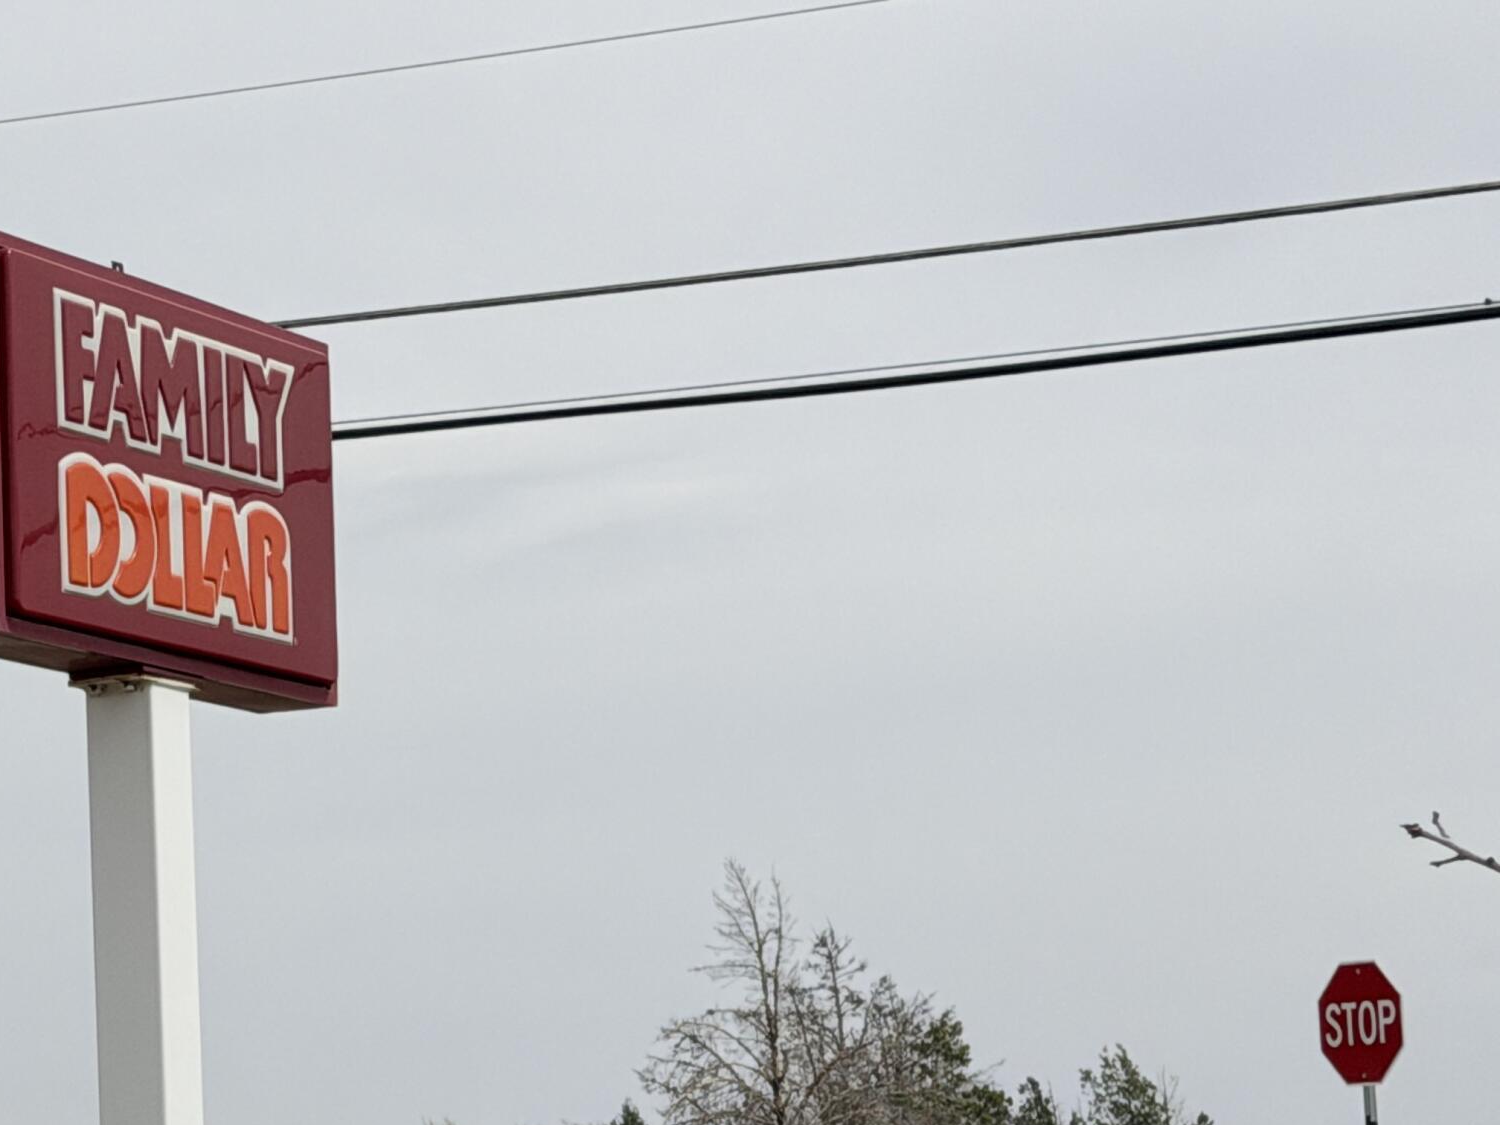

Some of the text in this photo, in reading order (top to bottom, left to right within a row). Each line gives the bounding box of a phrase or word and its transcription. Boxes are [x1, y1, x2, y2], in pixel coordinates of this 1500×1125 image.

[54, 287, 295, 491] FAMILY
[59, 452, 293, 643] DOLLAR
[1325, 999, 1396, 1048] STOP
